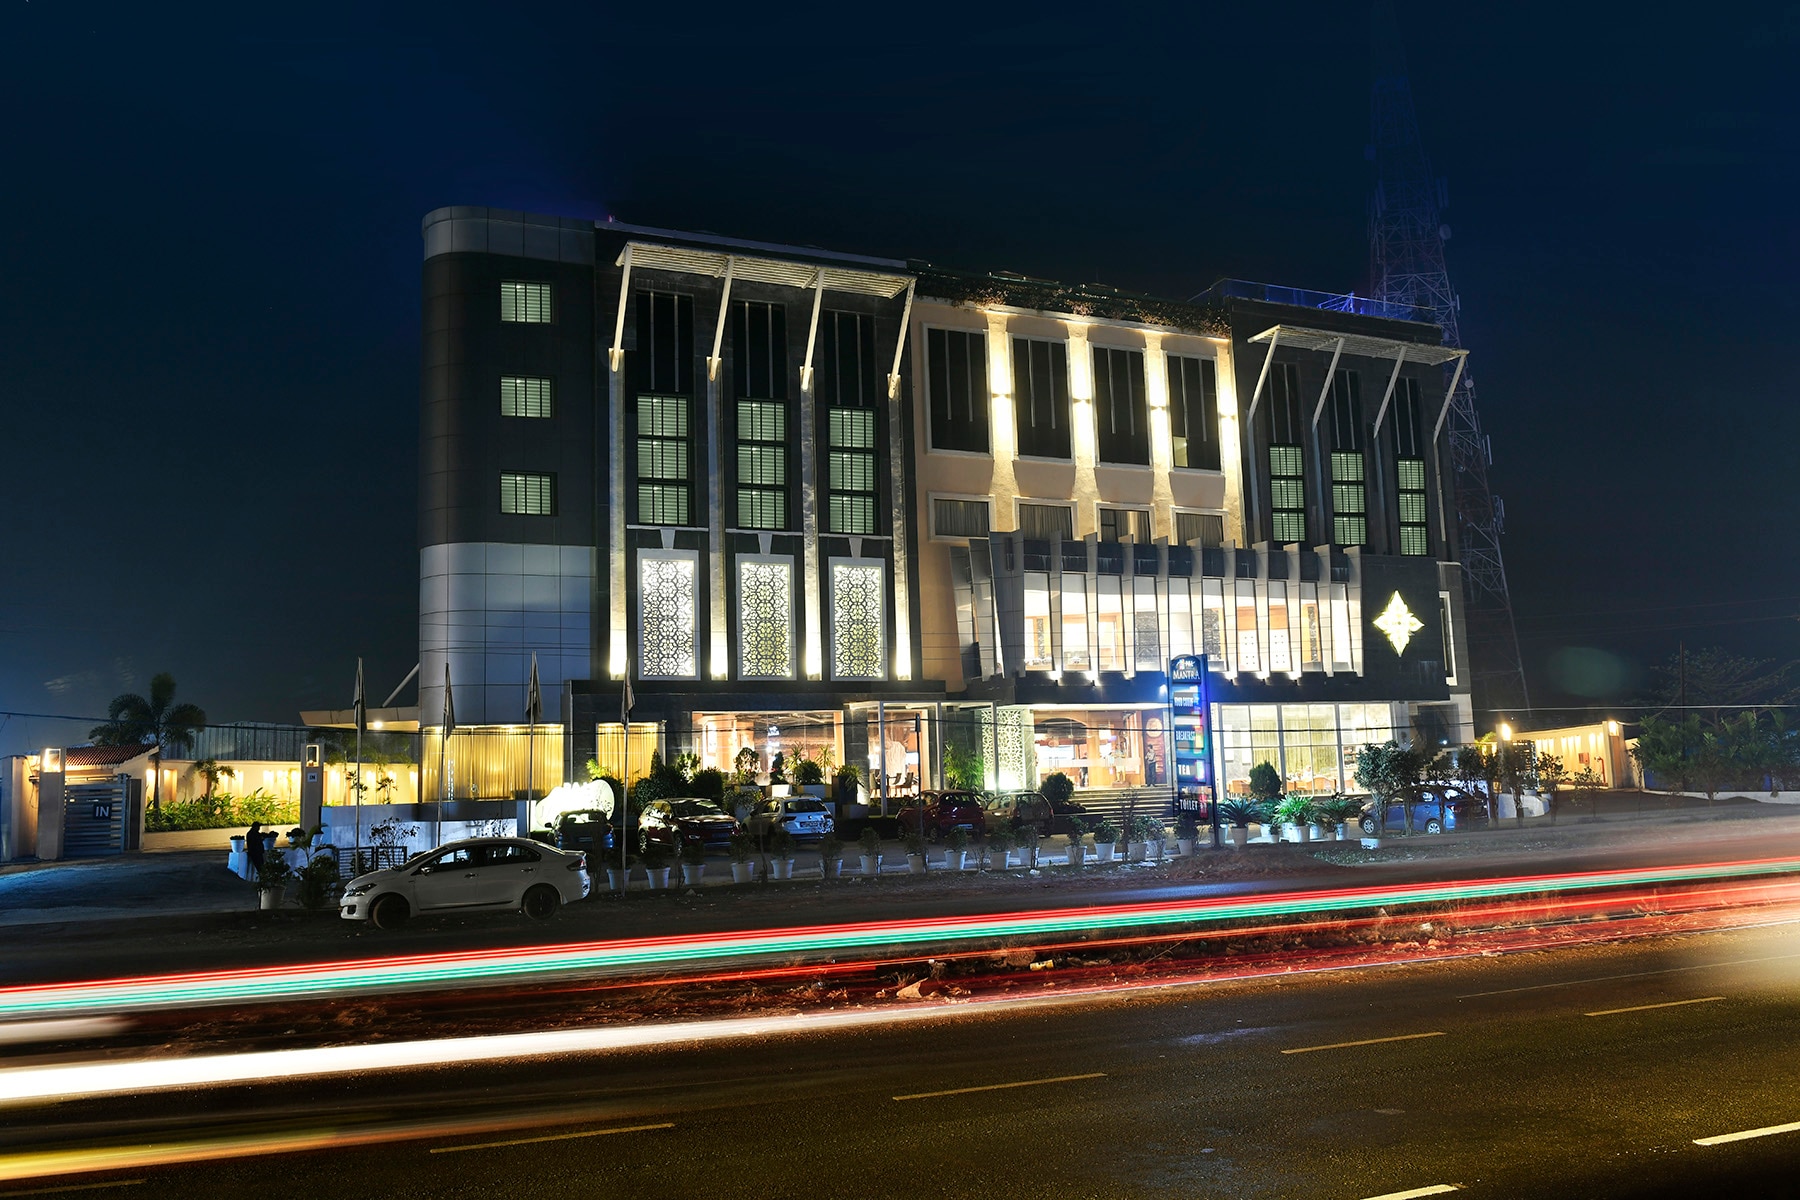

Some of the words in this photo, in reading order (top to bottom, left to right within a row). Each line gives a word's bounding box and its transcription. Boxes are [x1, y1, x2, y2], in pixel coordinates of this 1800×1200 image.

[1173, 670, 1200, 680] MANTRA
[1178, 764, 1191, 776] TEA
[1179, 799, 1198, 811] TOILET
[96, 806, 109, 817] IN
